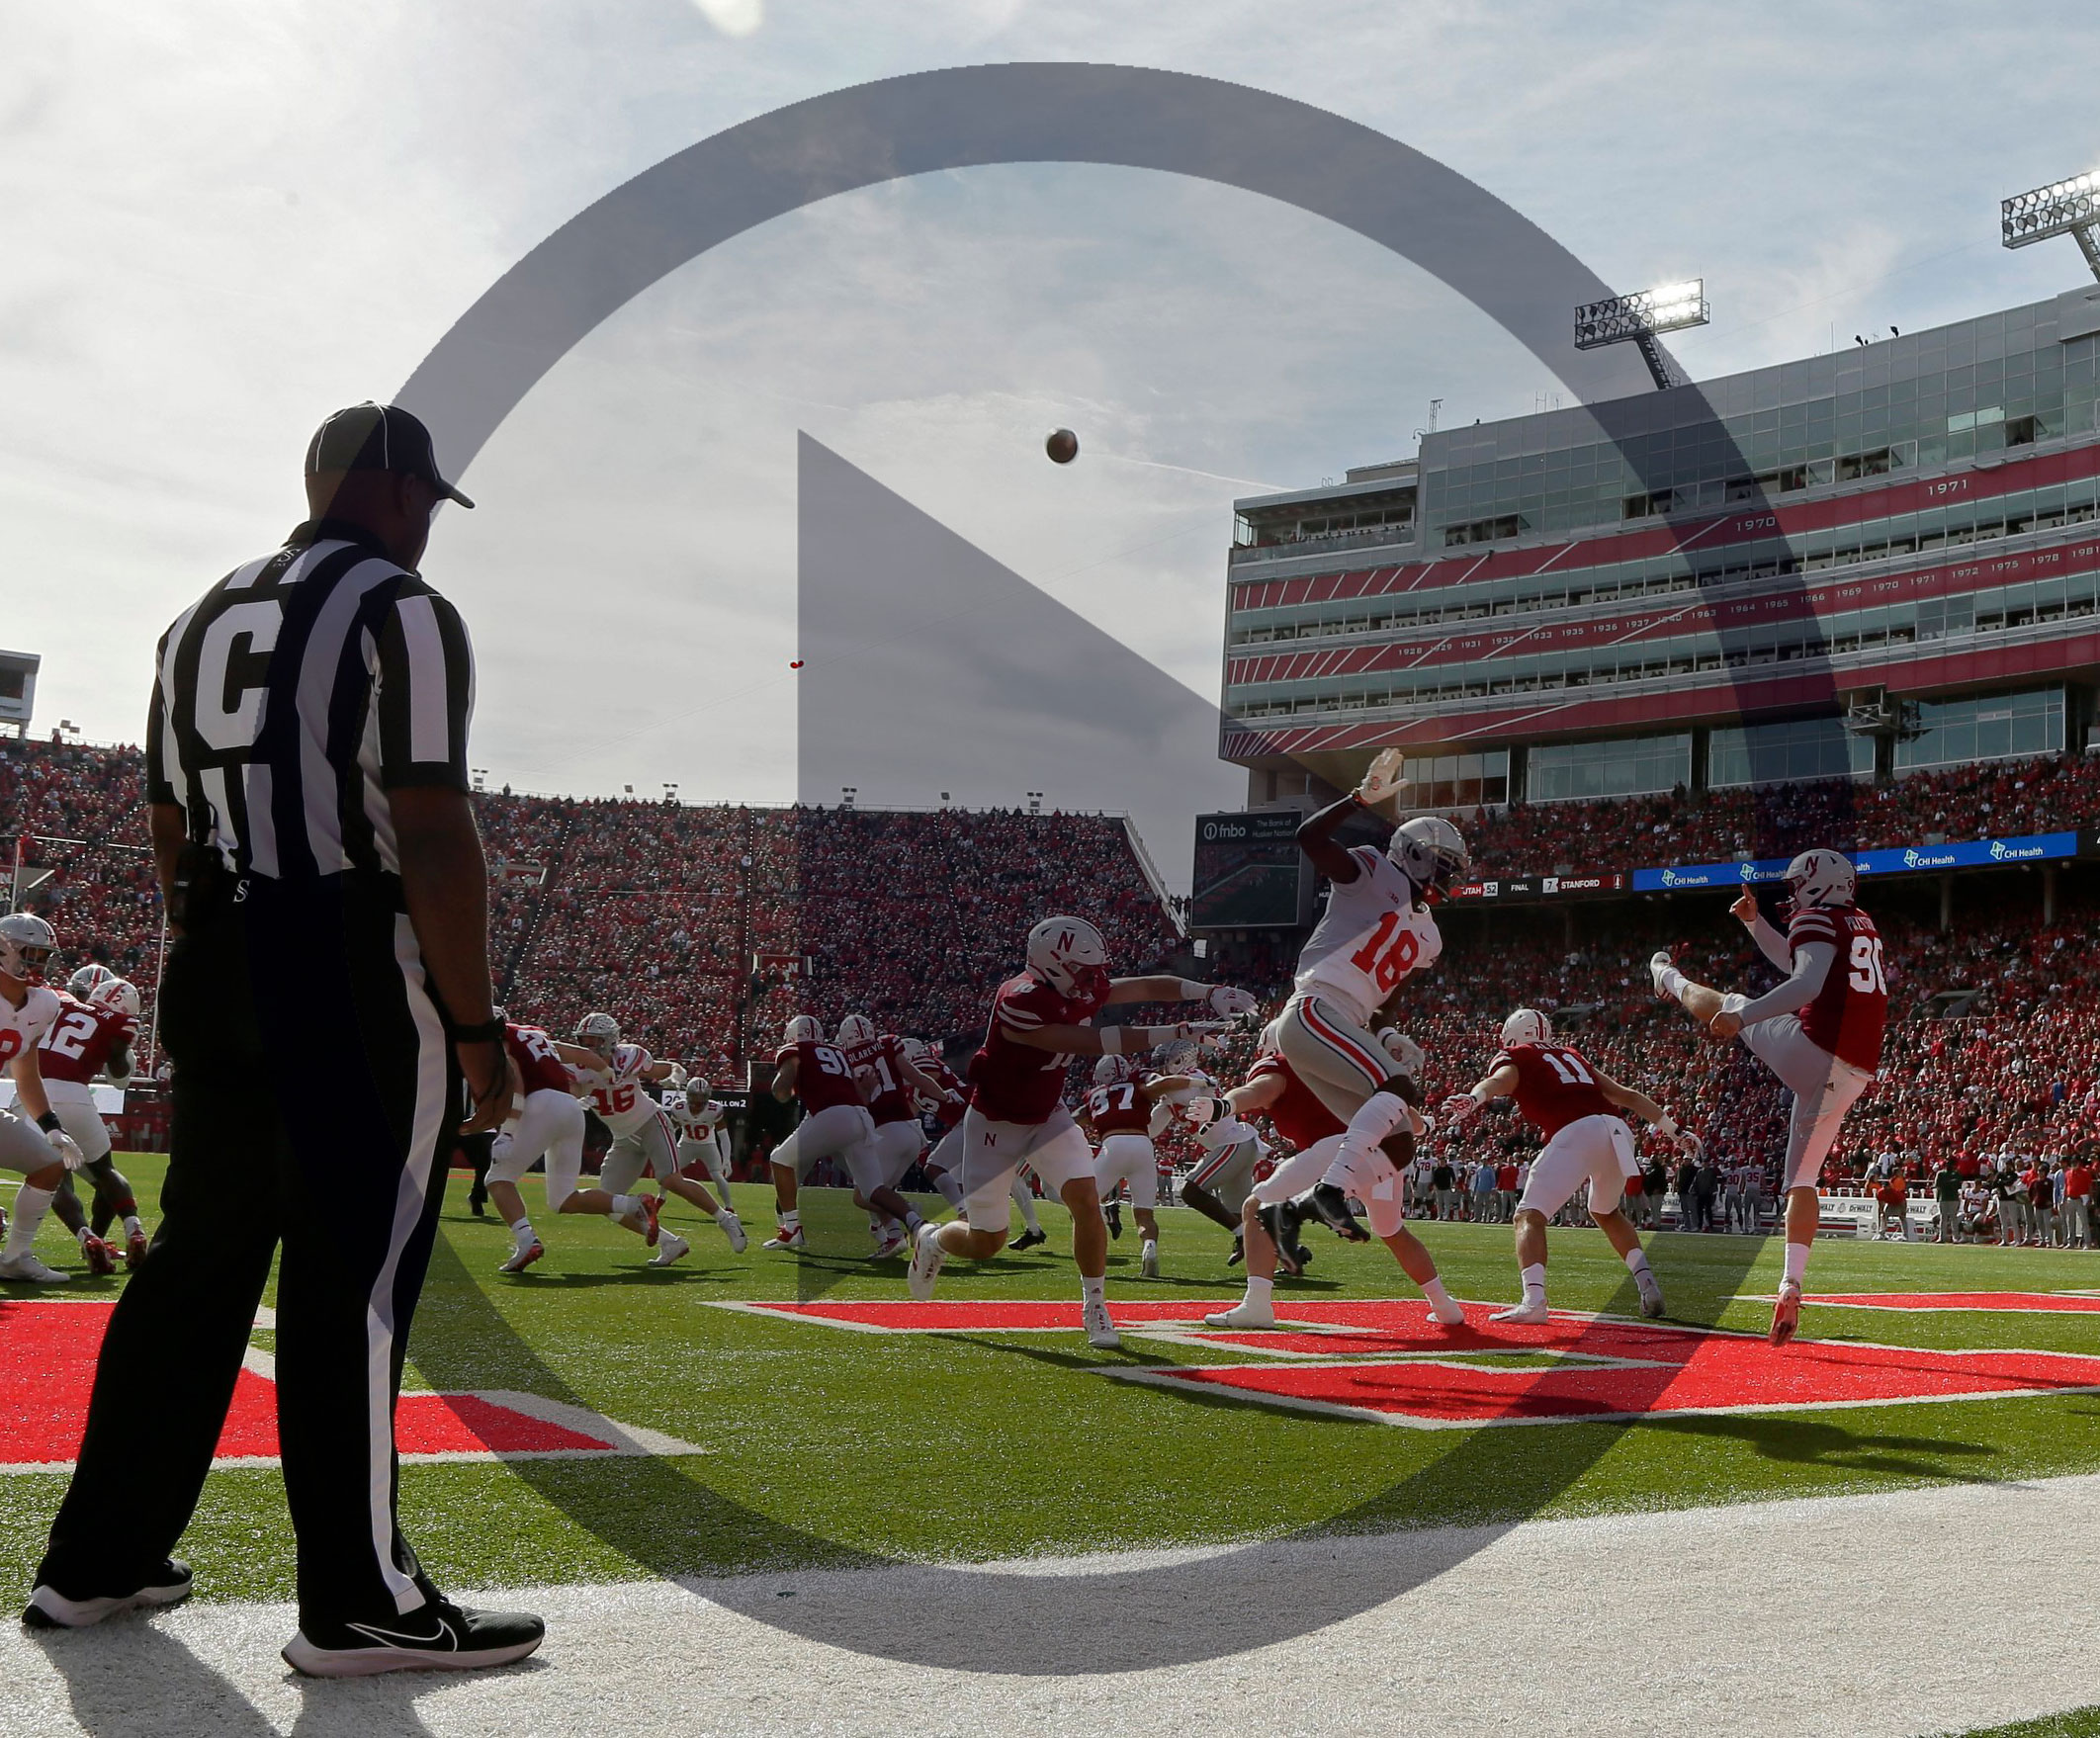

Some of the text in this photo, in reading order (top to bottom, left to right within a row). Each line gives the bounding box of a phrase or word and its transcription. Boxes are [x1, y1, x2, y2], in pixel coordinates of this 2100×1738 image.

[1928, 478, 1969, 496] 1971
[1736, 516, 1776, 532] 1970
[1461, 640, 1481, 649] 1931
[1529, 631, 1552, 641] 1933
[1562, 627, 1584, 637] 1935
[1593, 623, 1618, 633] 1936
[1626, 618, 1650, 629] 1937
[1692, 609, 1716, 619] 1963
[1730, 603, 1756, 614] 1964
[1765, 599, 1789, 610] 1965
[1800, 593, 1825, 603] 1966
[1837, 587, 1862, 598] 1969
[1873, 580, 1899, 592] 1970
[1910, 574, 1935, 585] 1971
[1952, 566, 1979, 578] 1972
[1991, 560, 2019, 572] 1975
[2032, 553, 2059, 565] 1978
[2072, 546, 2100, 559] 1981
[195, 598, 284, 751] C
[1219, 824, 1247, 838] fnbo
[2004, 846, 2044, 859] CHI Health
[1917, 855, 1956, 866] CHI Health
[1674, 876, 1708, 886] CHI Health
[1753, 870, 1788, 880] CHI Health
[1486, 885, 1497, 894] 52
[1511, 883, 1530, 893] FINAL
[1560, 879, 1600, 890] STANFORD
[1057, 930, 1076, 953] N
[1351, 912, 1420, 995] 18
[815, 1047, 853, 1080] 91
[1542, 1053, 1595, 1086] 11
[741, 1099, 746, 1108] 2
[1090, 1082, 1135, 1119] 37
[685, 1124, 710, 1141] 10
[984, 1132, 997, 1147] N
[1419, 1162, 1432, 1172] 78
[1727, 1173, 1740, 1185] 30
[1746, 1172, 1760, 1183] 35
